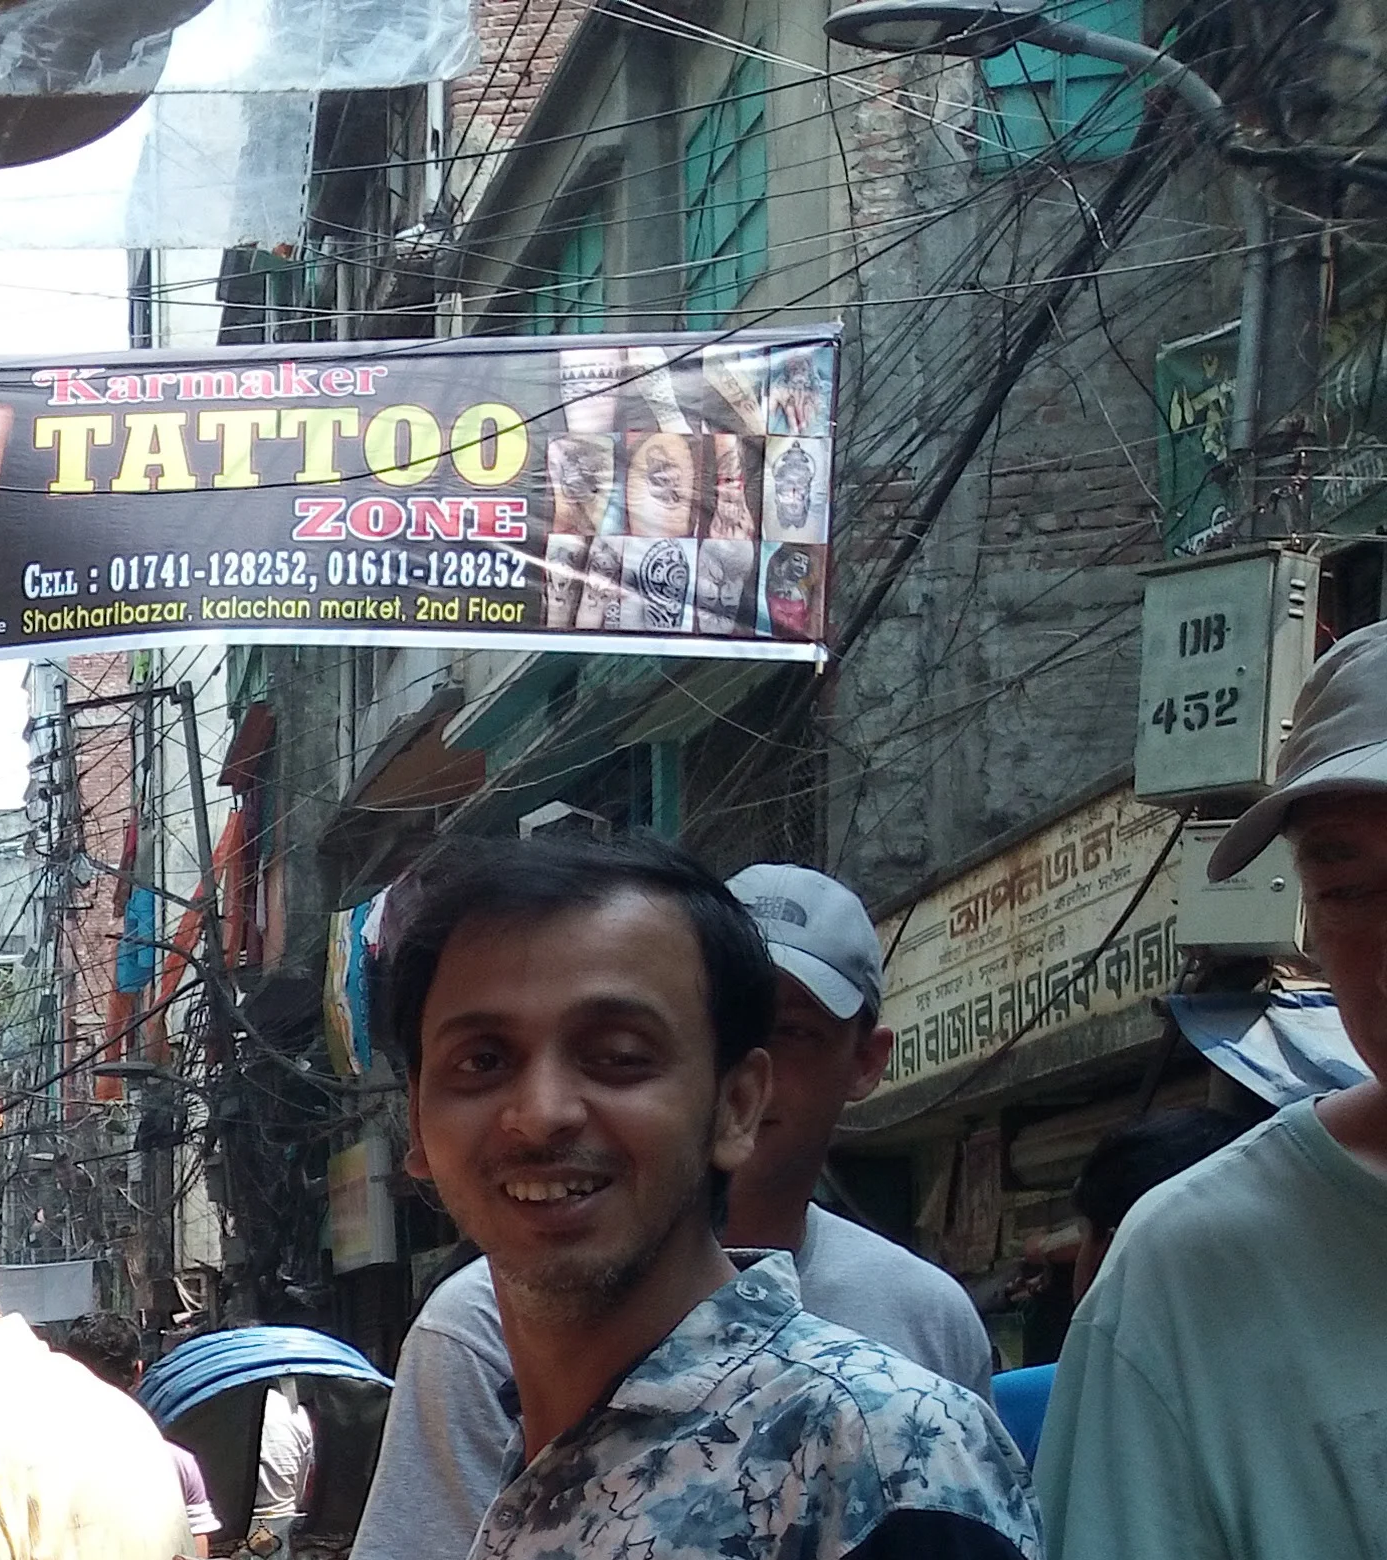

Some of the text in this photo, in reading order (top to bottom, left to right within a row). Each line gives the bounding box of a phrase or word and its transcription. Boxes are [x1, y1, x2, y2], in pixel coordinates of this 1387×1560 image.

[32, 362, 388, 405] Karmaker
[33, 402, 533, 496] TATTOO
[291, 496, 531, 542] ZONE
[109, 551, 318, 592] 01741-128252,
[327, 549, 527, 588] 01611-128252
[22, 595, 525, 635] Shakharibazar, kalachan market, 2nd Floor
[1179, 612, 1229, 659] DB
[1151, 686, 1241, 736] 452
